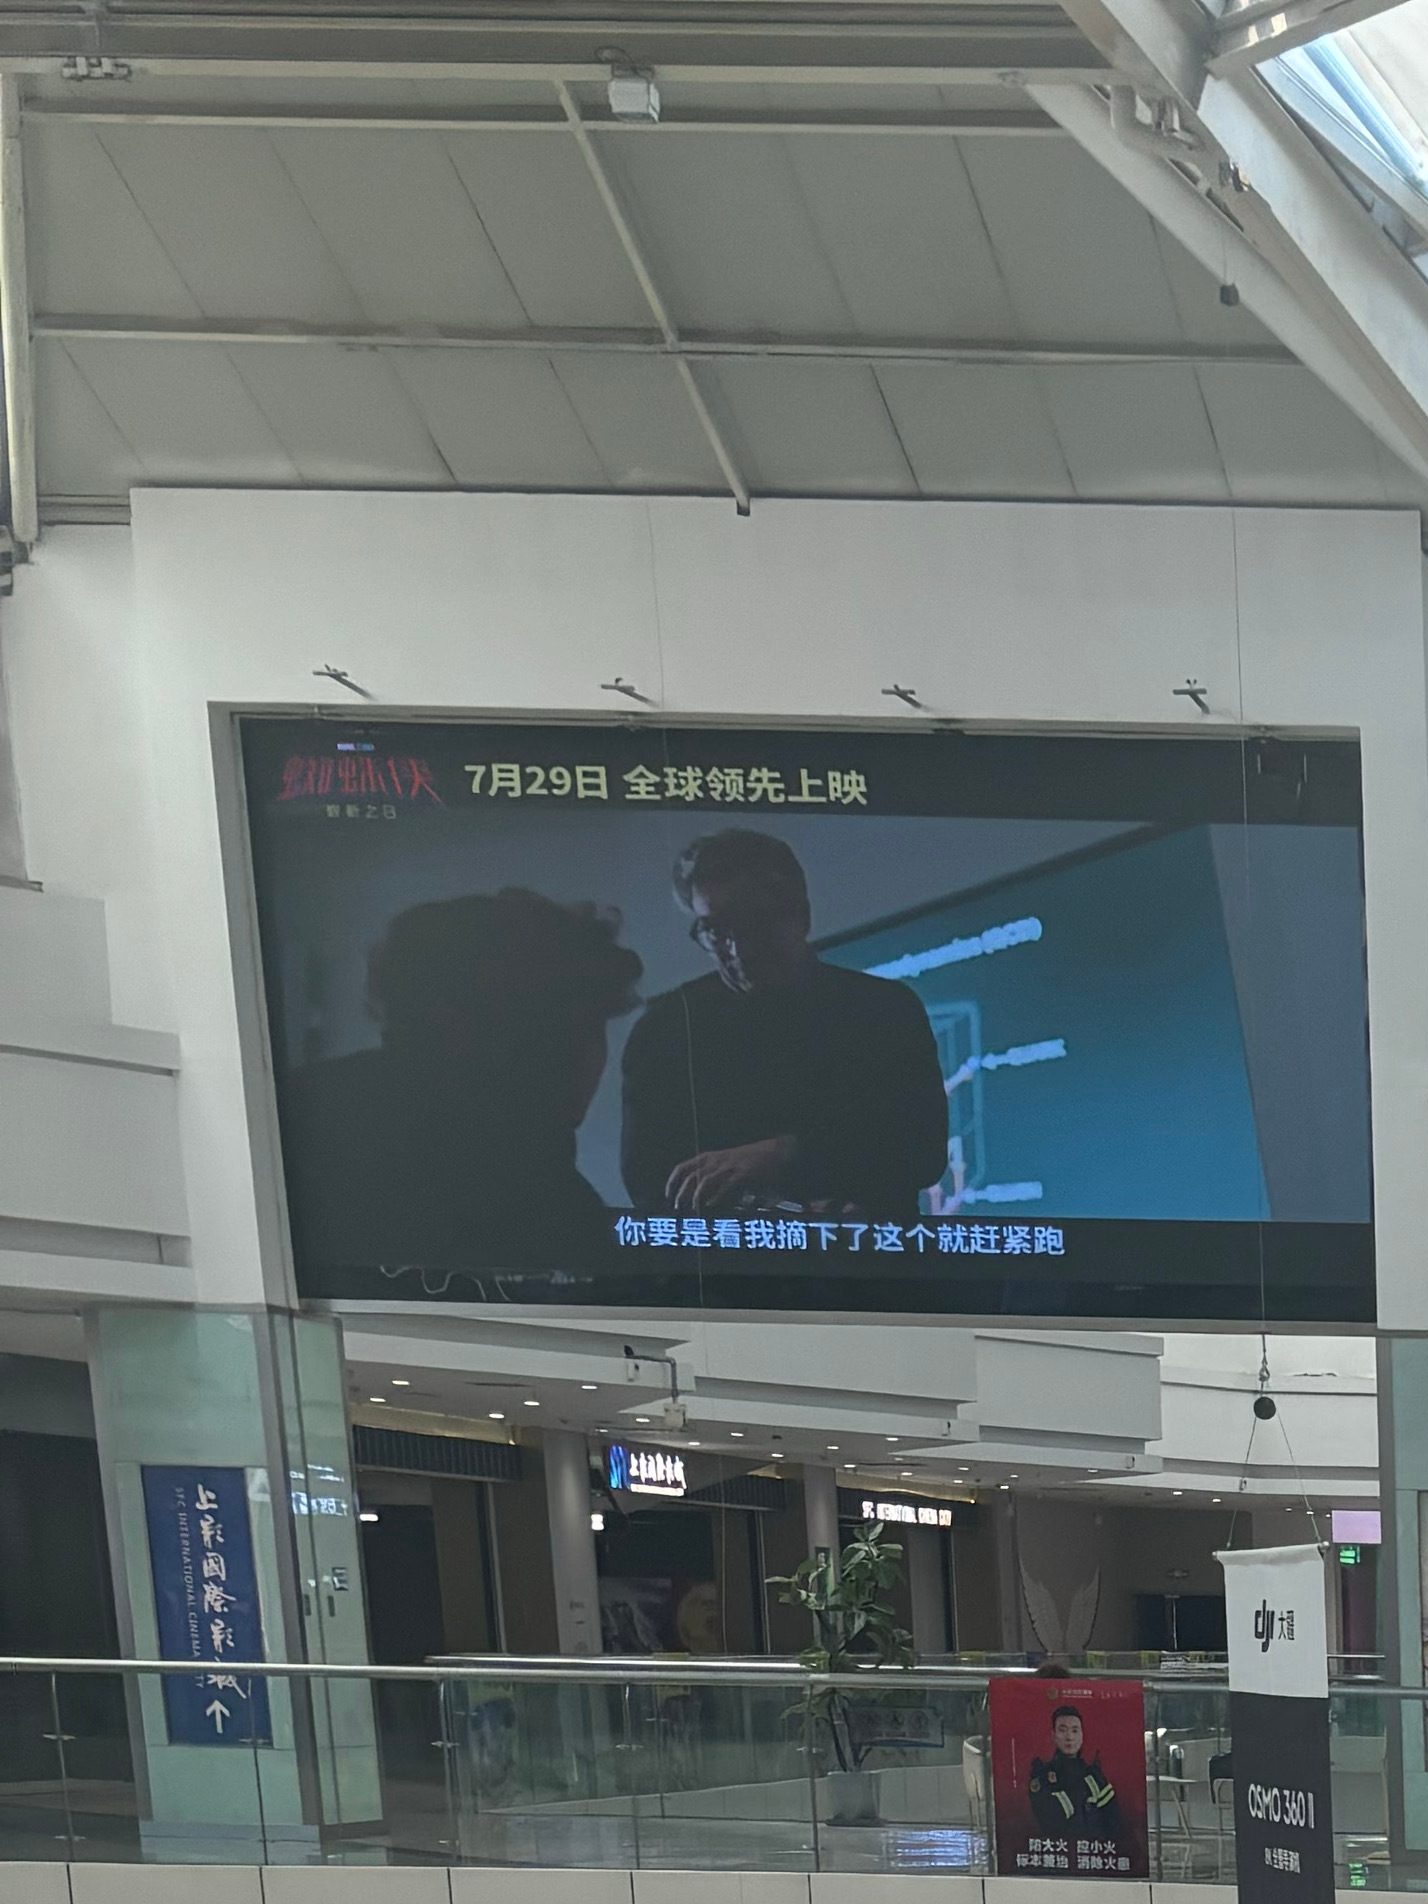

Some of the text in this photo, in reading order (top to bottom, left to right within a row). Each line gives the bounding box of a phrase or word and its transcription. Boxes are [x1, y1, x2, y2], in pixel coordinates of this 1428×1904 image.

[464, 763, 868, 806] 7月29日 全球领先上映
[614, 1216, 1065, 1256] 你要是看我摘下了这个就赶紧跑
[1249, 1783, 1281, 1823] OSMO
